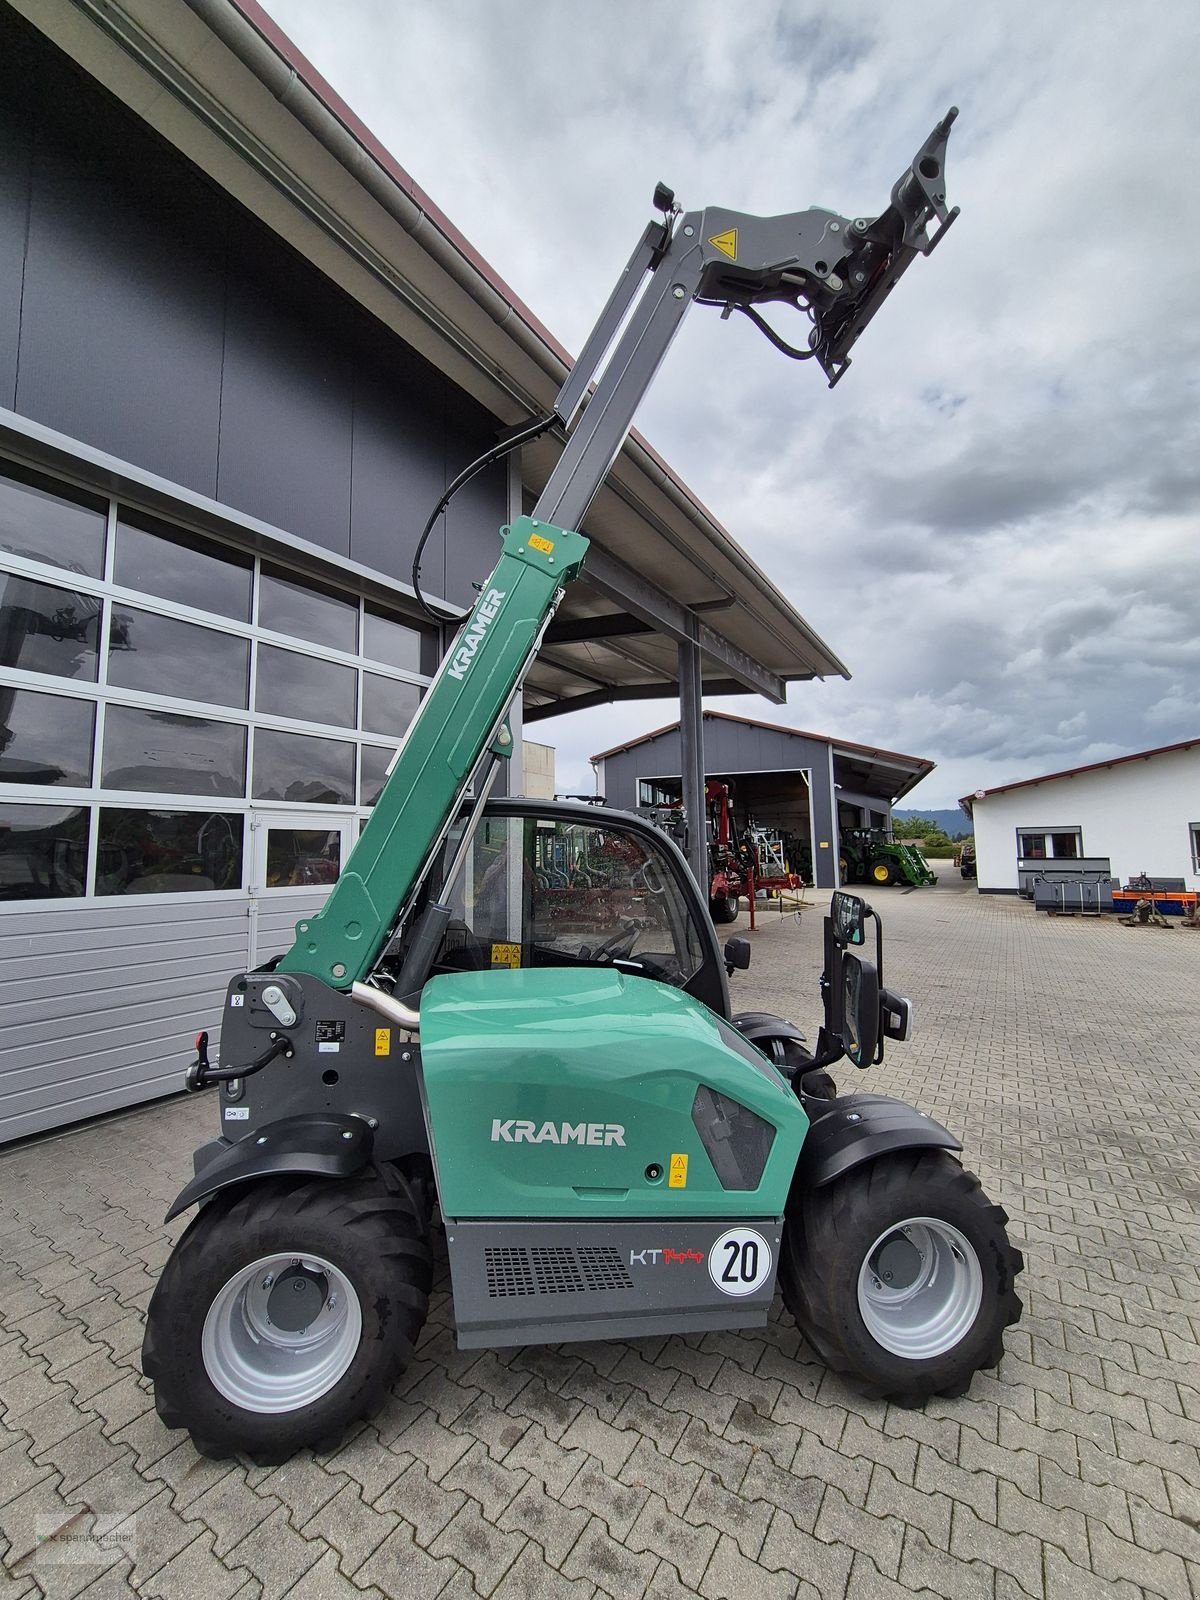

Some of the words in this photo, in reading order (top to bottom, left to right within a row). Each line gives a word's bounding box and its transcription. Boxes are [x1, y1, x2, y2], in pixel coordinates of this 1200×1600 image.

[448, 588, 506, 681] KRAMER
[490, 1118, 627, 1147] KRAMER
[721, 1240, 759, 1283] 20
